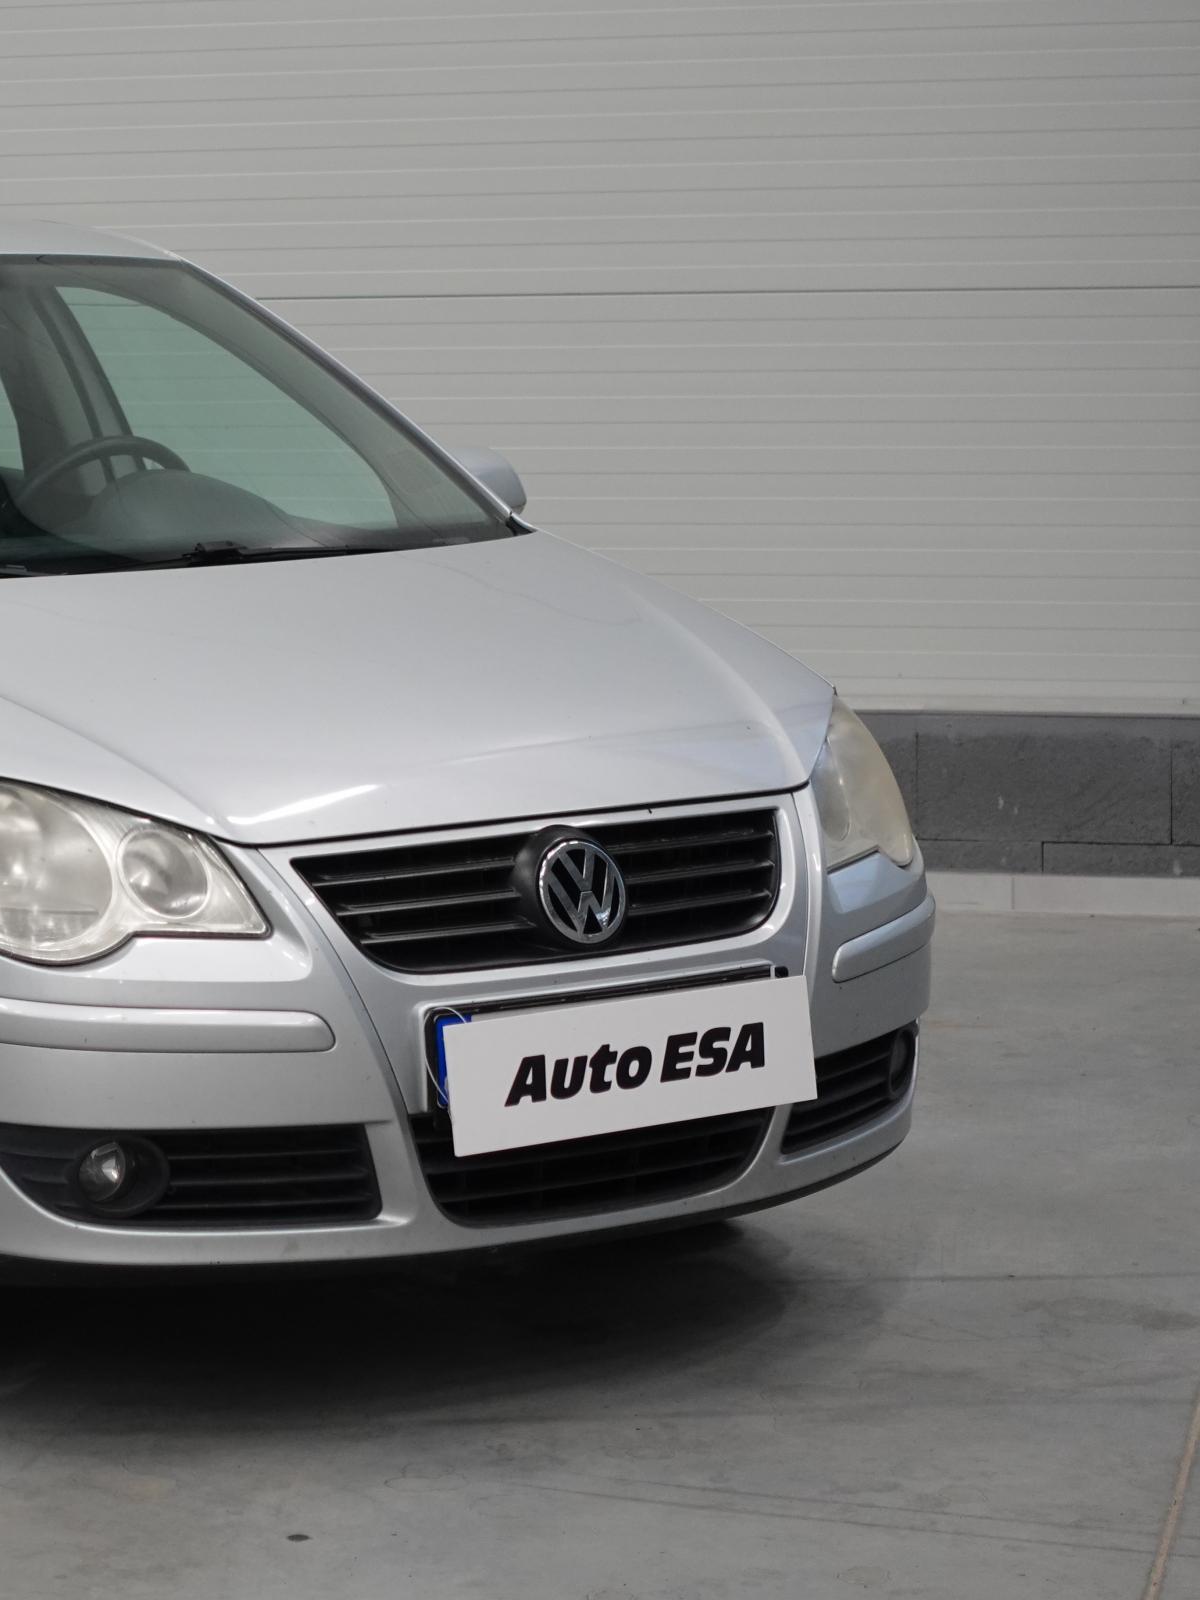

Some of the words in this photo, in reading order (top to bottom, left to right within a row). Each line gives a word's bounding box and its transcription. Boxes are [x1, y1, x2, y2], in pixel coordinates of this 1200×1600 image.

[541, 842, 625, 943] VW
[504, 1043, 653, 1107] Auto
[659, 1021, 766, 1083] ESA
